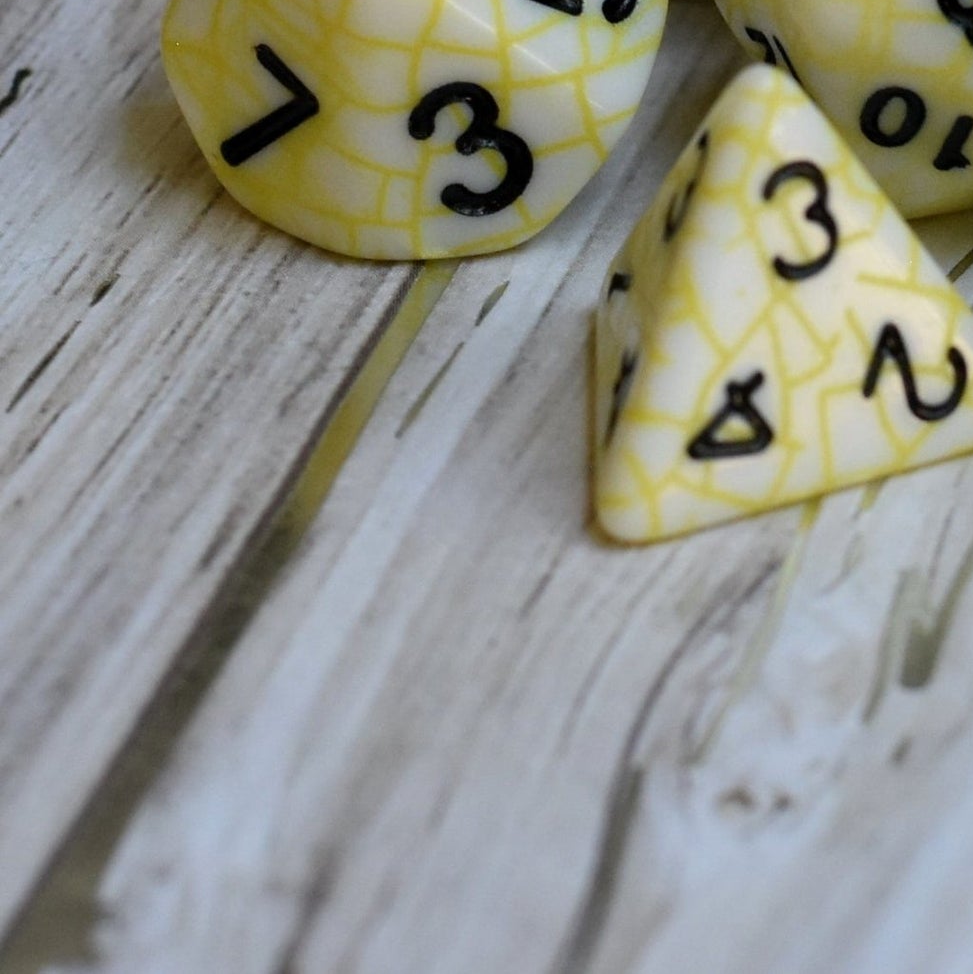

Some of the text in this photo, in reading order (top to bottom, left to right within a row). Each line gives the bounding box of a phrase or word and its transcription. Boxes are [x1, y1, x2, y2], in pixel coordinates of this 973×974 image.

[219, 43, 321, 168] 7
[407, 80, 535, 218] 3
[762, 159, 840, 283] 3
[686, 370, 775, 461] 4
[862, 322, 969, 423] 2
